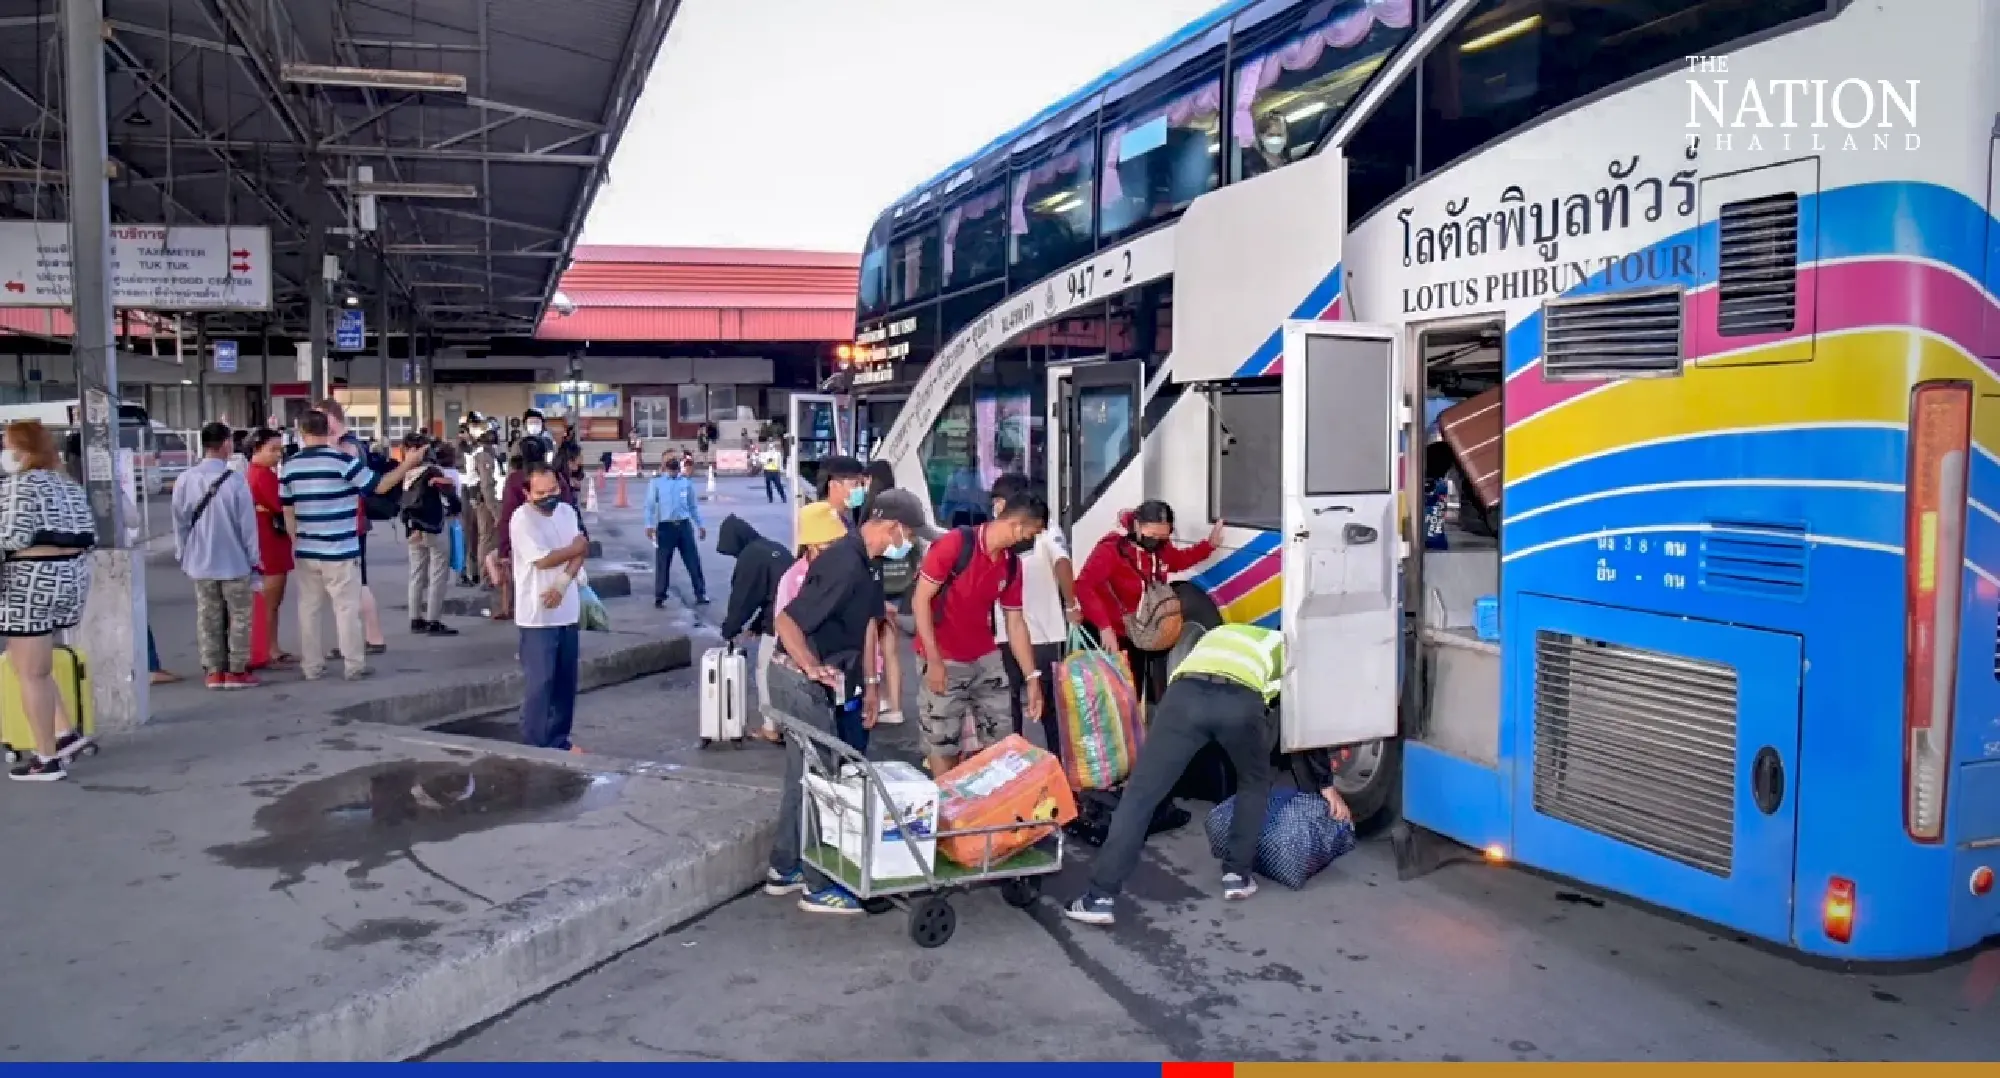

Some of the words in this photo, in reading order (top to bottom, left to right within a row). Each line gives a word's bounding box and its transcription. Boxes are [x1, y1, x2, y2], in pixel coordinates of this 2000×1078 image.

[1397, 137, 1699, 267] โลตัสพิบูลทัวร์
[137, 260, 162, 270] TUK
[166, 261, 190, 270] TUK
[1067, 263, 1095, 304] 947
[1122, 249, 1134, 284] 2
[1402, 278, 1478, 313] LOTUS
[1486, 257, 1592, 303] PHIBUN
[1599, 244, 1694, 287] TOUR
